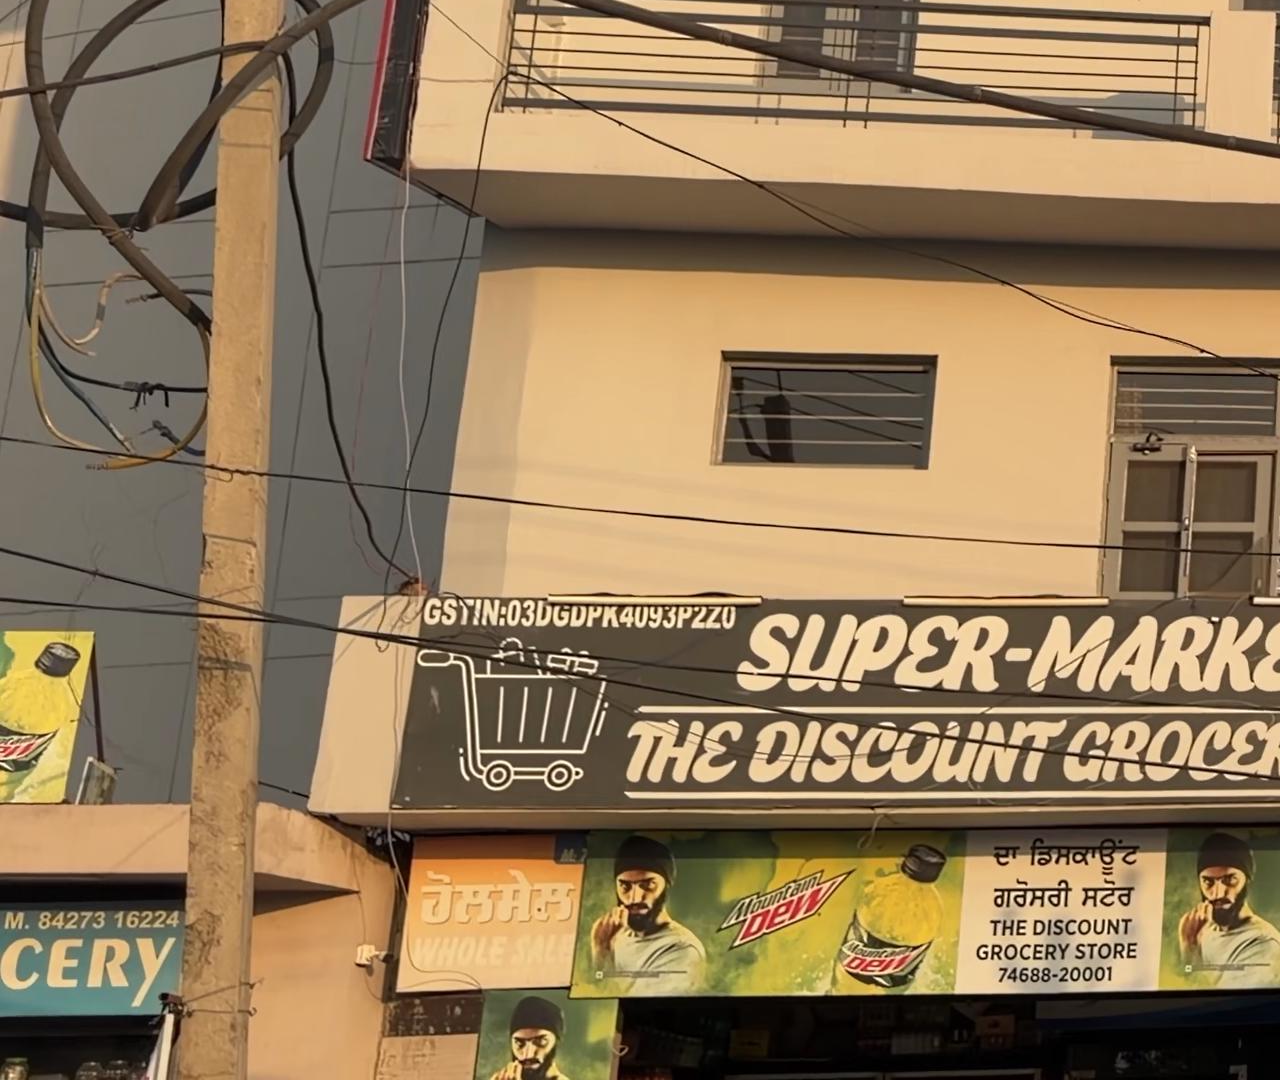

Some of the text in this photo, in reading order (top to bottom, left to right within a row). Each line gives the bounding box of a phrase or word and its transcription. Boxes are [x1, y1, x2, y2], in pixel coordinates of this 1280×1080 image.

[624, 719, 743, 784] THE
[748, 719, 1067, 784] DISCOUNT
[993, 838, 1140, 875] ਦਾ ਡਿਸਕਾਊਂਟ
[722, 874, 821, 926] Mountain
[993, 878, 1135, 908] ਗਰੋਸਰੀ ਸਟੋਰ
[5, 911, 180, 930] M. 84273 16224
[990, 918, 1132, 936] THE DISCOUNT
[414, 935, 508, 968] WHOLE
[976, 942, 1138, 961] GROCERY STORE
[998, 966, 1113, 983] 74688-20001
